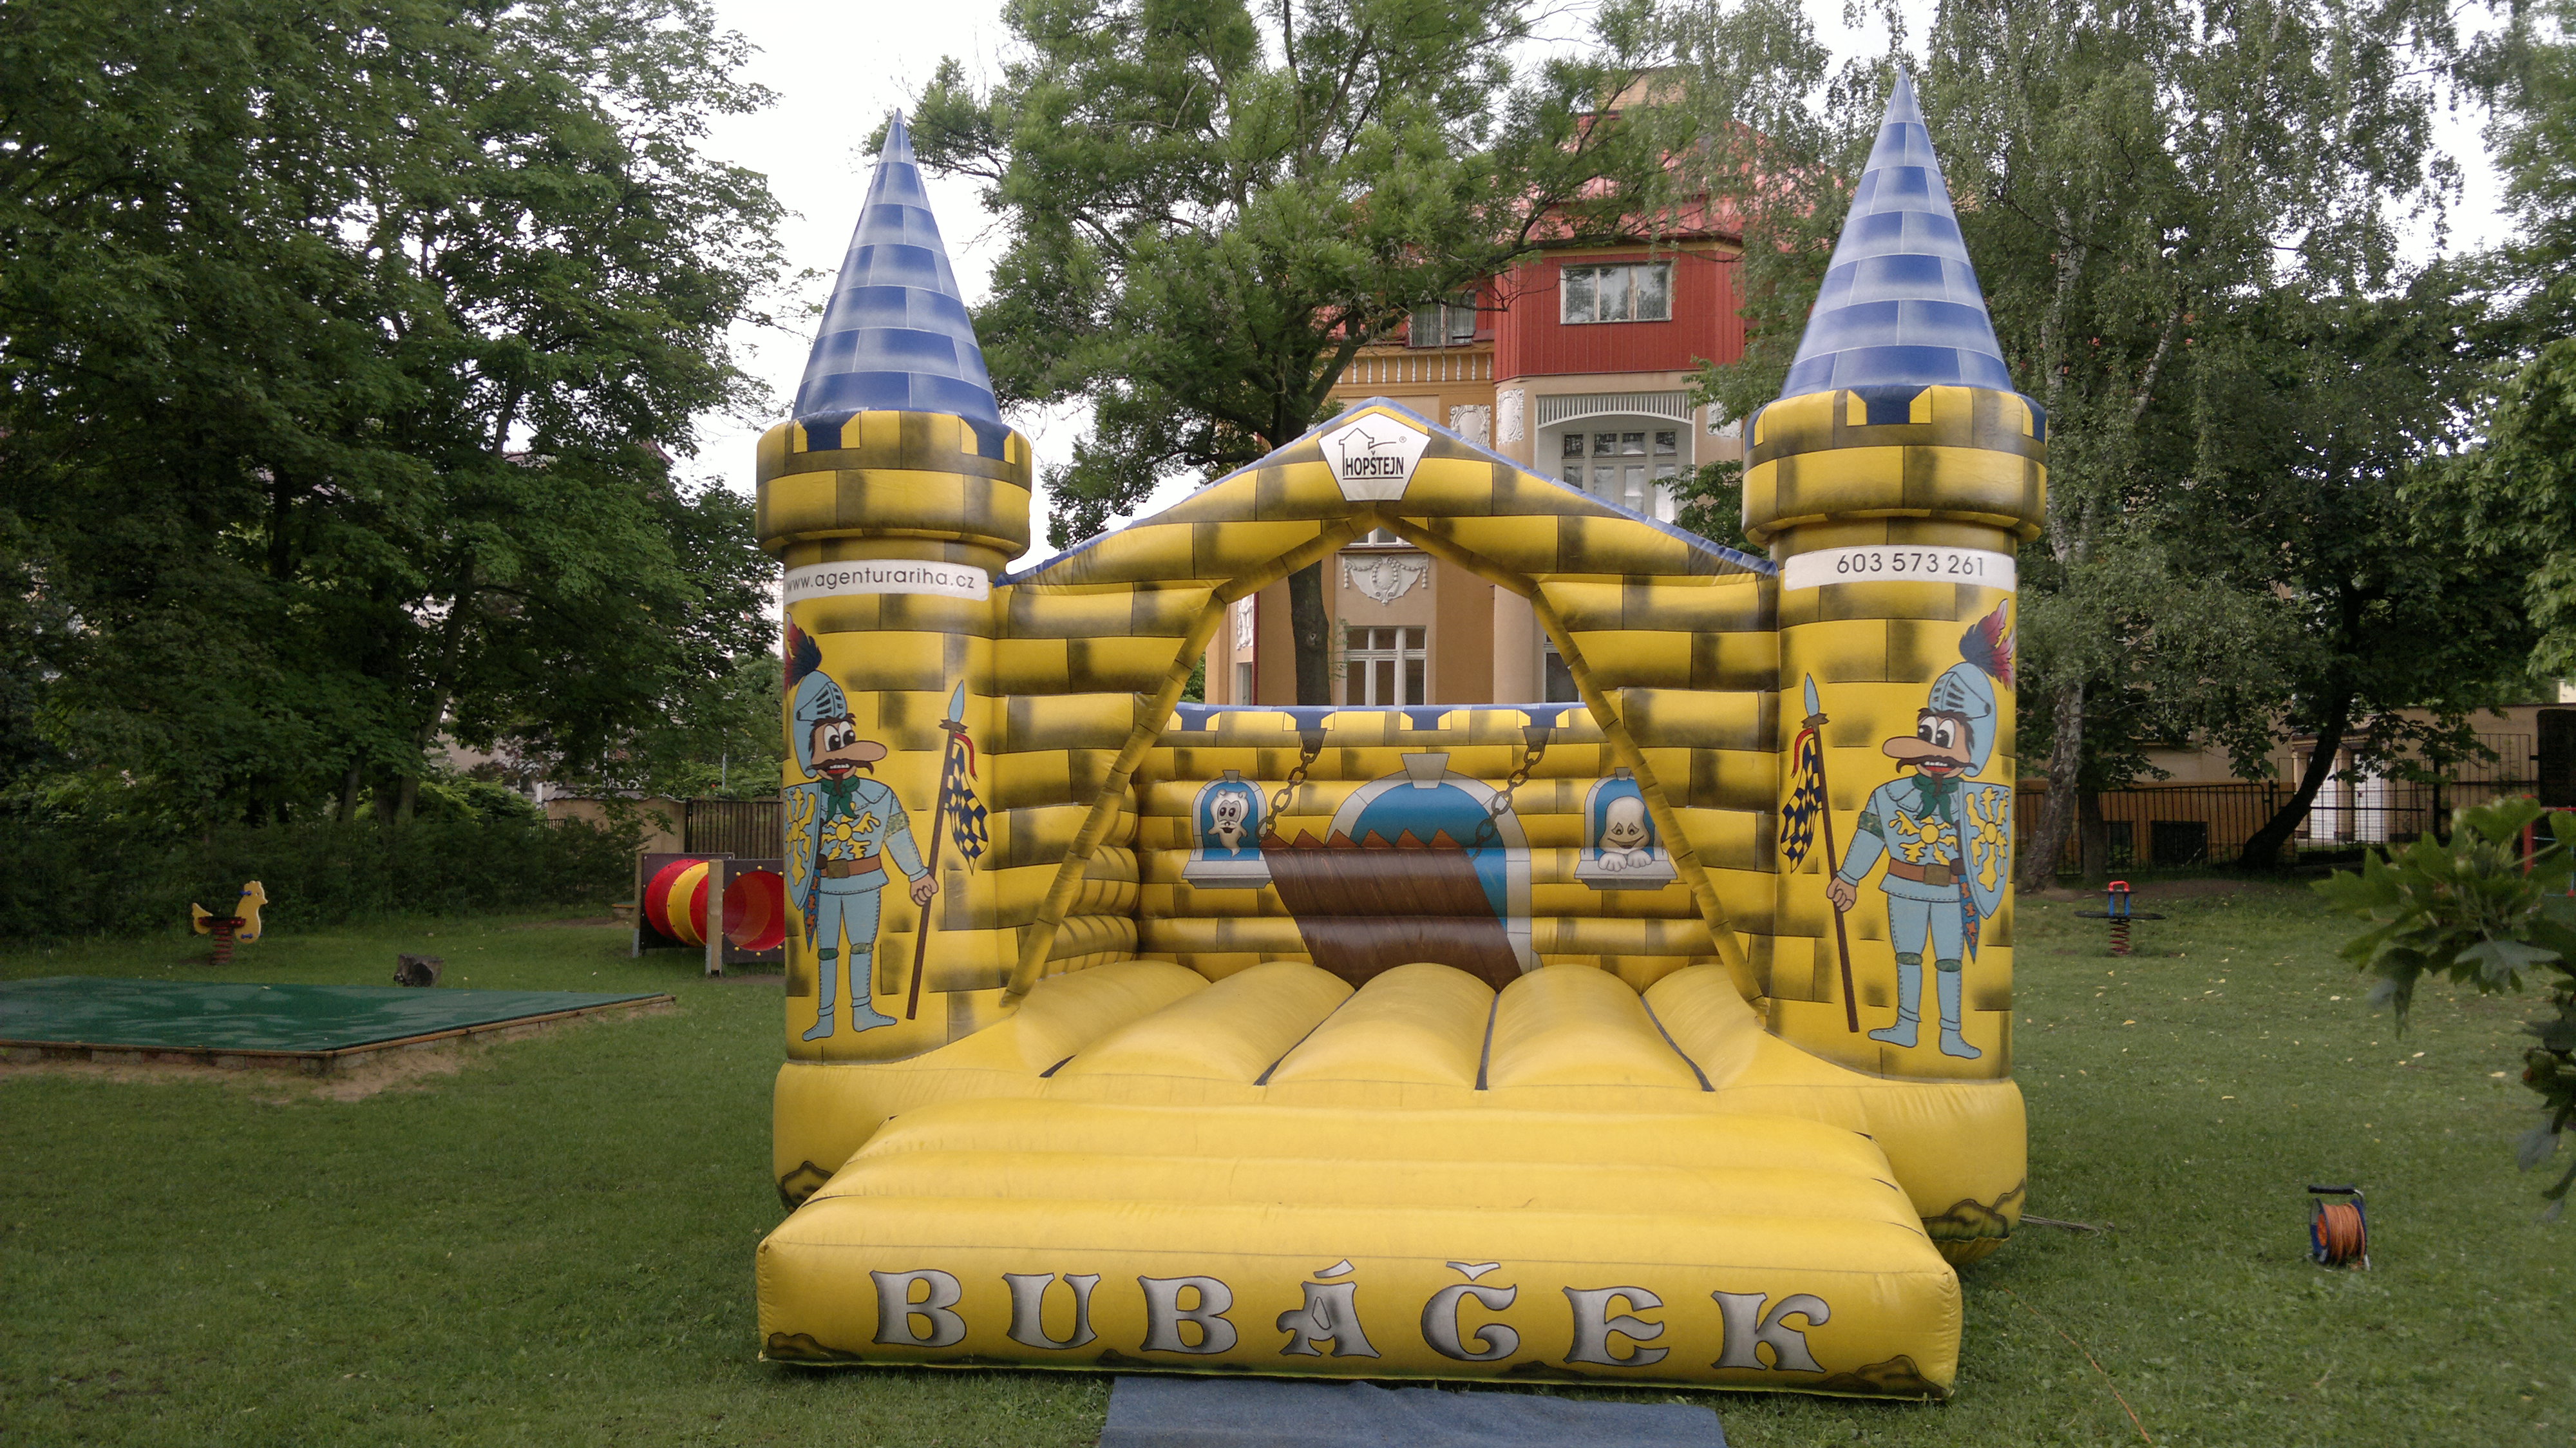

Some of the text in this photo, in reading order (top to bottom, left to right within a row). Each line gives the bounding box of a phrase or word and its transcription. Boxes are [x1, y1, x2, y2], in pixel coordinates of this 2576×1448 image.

[1345, 450, 1404, 476] HOPŠTEJN
[1837, 553, 1984, 576] 603 573 261
[786, 567, 975, 593] www.agenturariha.cz
[869, 1258, 1830, 1373] BUBÁČEK
